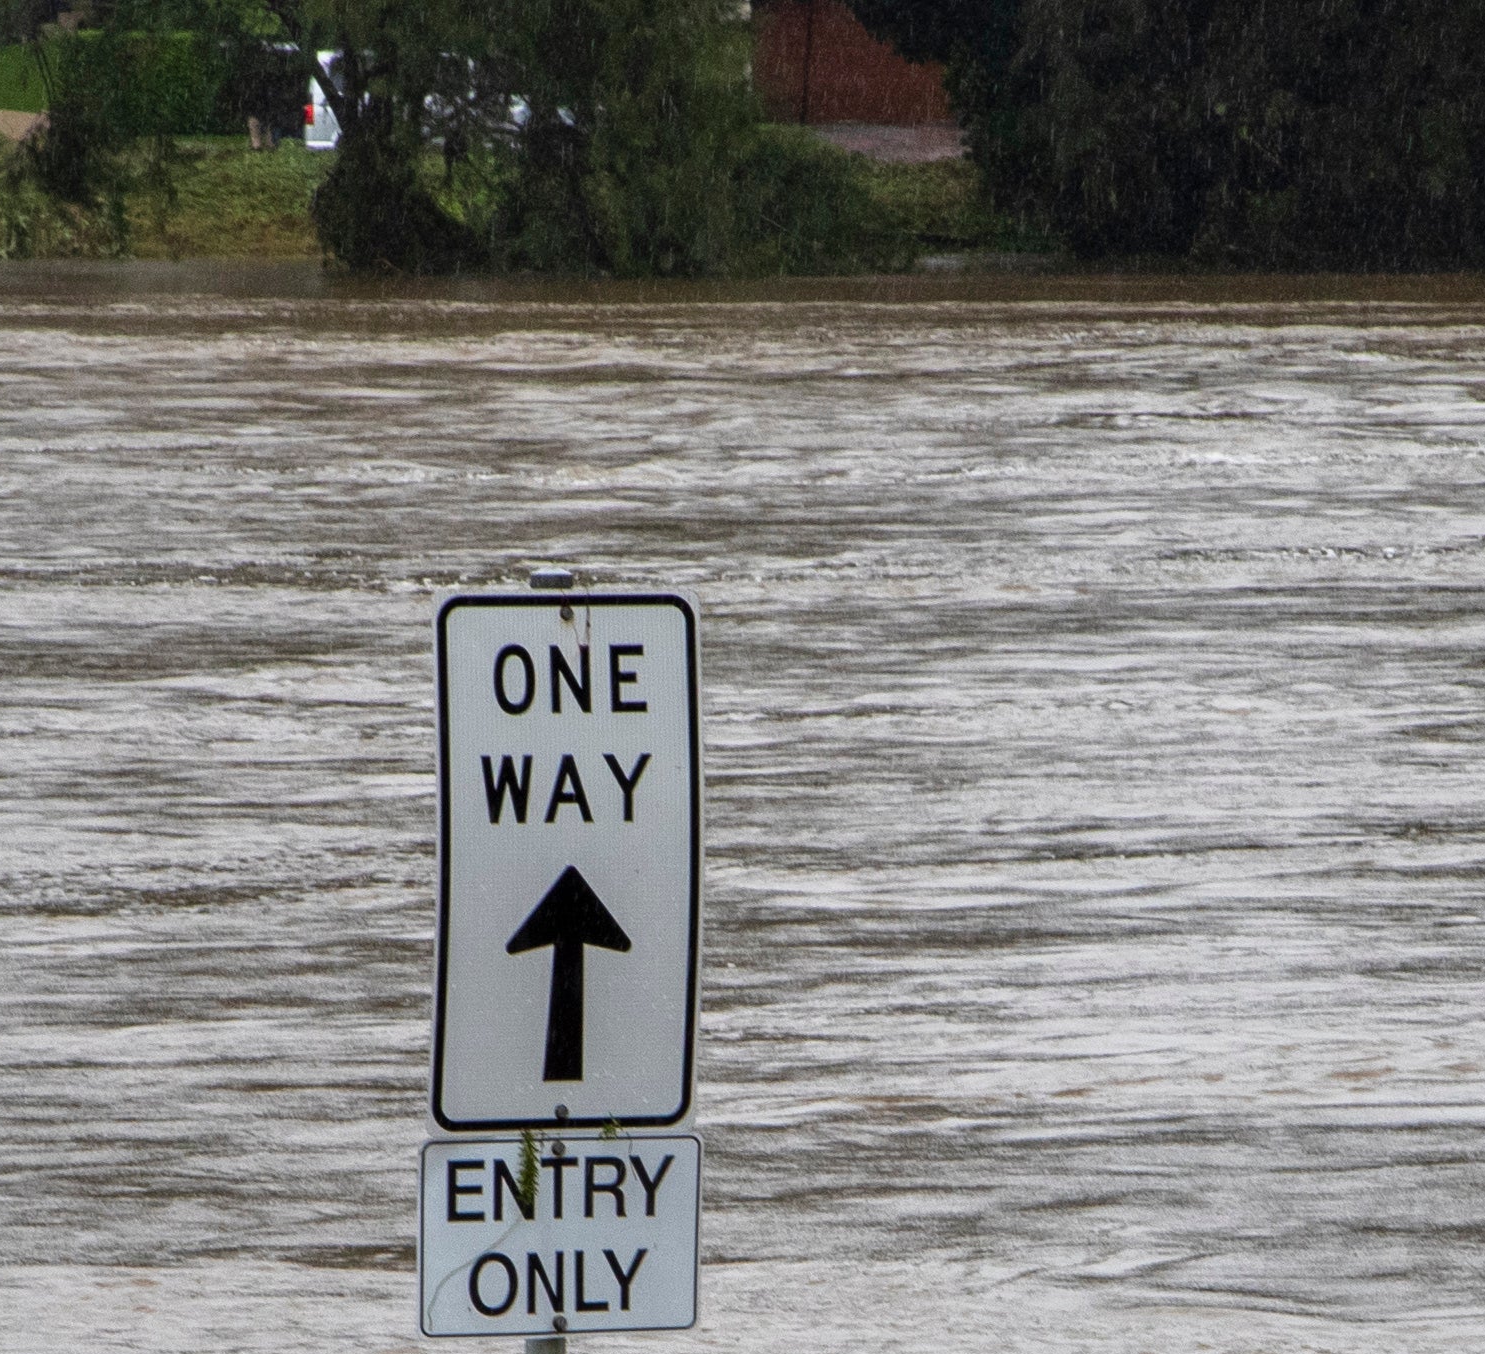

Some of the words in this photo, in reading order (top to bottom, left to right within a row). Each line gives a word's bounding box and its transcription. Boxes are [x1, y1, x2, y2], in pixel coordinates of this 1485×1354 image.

[492, 643, 648, 716] ONE
[480, 753, 652, 825] WAY
[446, 1154, 675, 1223] ENTRY
[468, 1248, 648, 1317] ONLY
